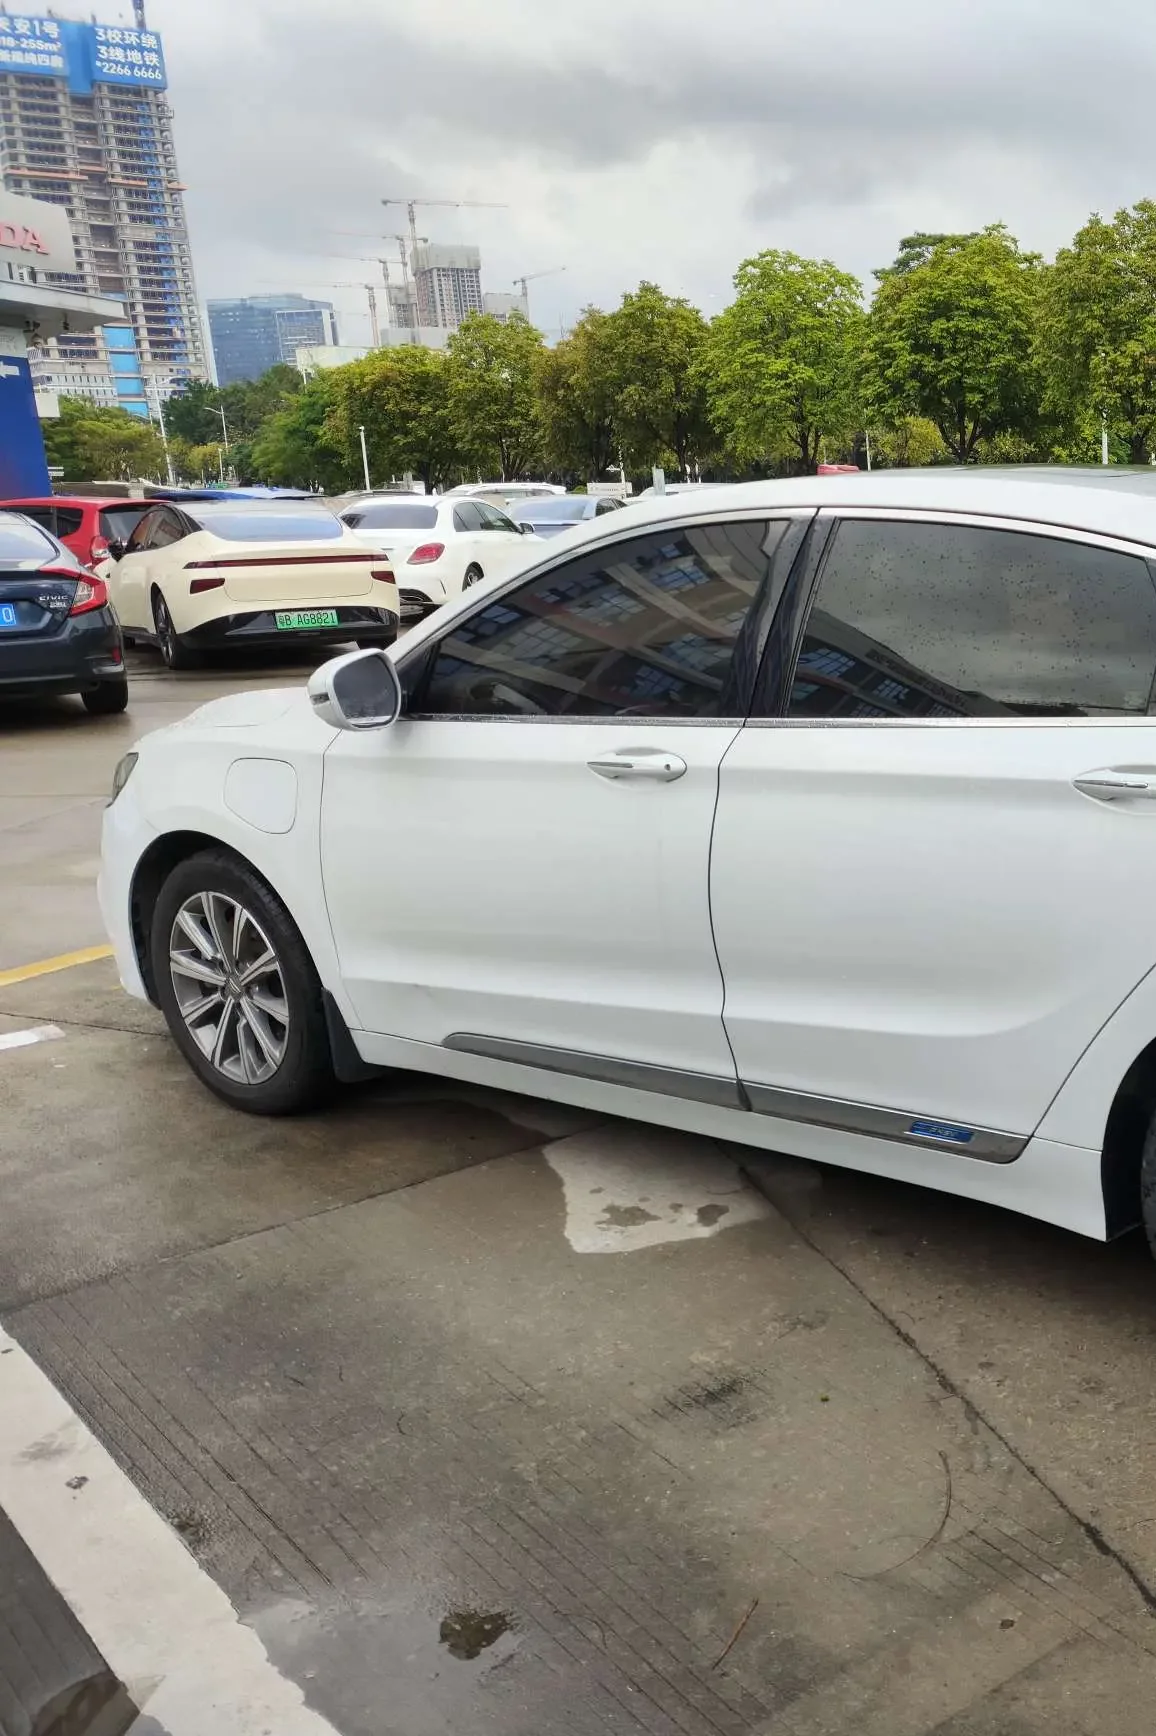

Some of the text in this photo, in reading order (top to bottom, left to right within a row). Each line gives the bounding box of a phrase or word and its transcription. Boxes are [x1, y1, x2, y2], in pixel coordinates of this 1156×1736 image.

[95, 27, 158, 49] 3校环绕
[96, 45, 160, 67] 3线地铁
[103, 62, 162, 80] 2266 6666
